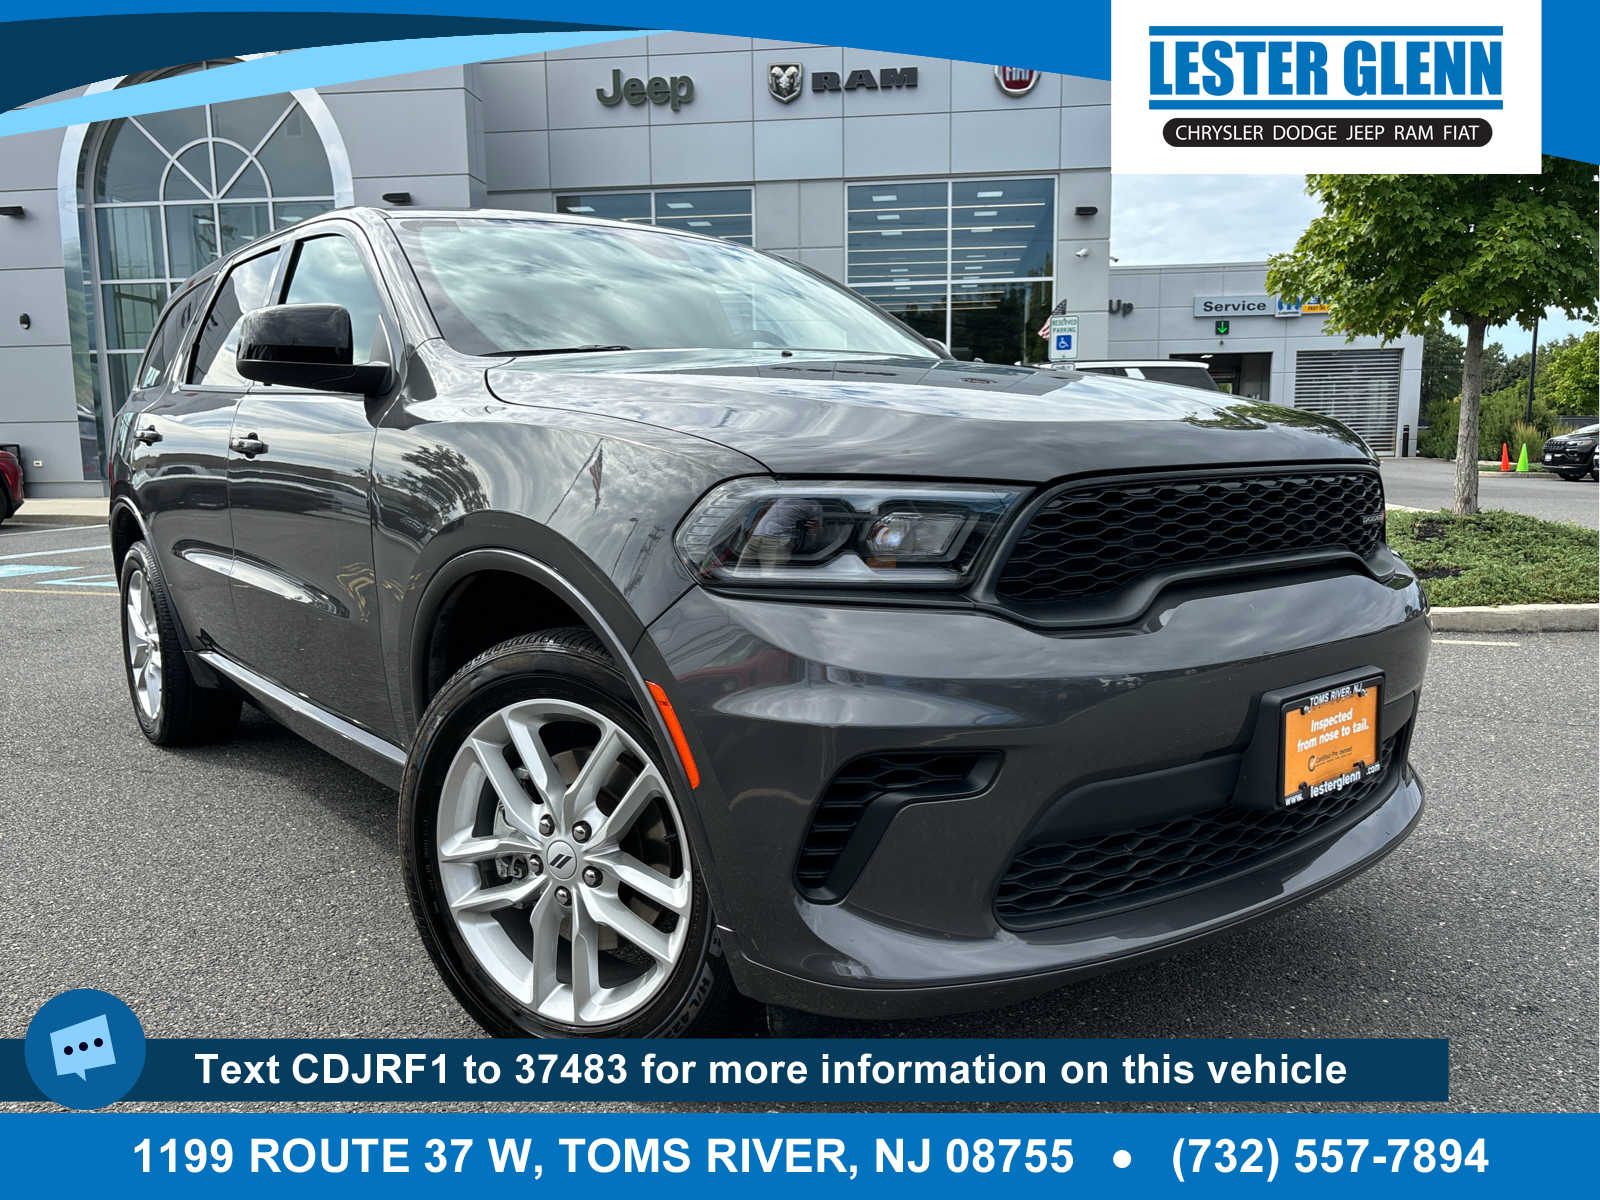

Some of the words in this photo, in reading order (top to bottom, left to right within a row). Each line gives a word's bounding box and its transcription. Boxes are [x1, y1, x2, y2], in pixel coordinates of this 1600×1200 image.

[596, 68, 694, 112] Jeep
[811, 67, 918, 93] RAM
[1108, 299, 1134, 318] Up
[1203, 300, 1267, 313] Service
[1309, 693, 1329, 707] TOMS
[1311, 707, 1353, 732] Inspected
[1297, 737, 1317, 752] from
[1319, 729, 1339, 744] nose
[1341, 725, 1351, 737] to
[1352, 718, 1369, 733] tail.
[1310, 771, 1361, 798] lesterglenn
